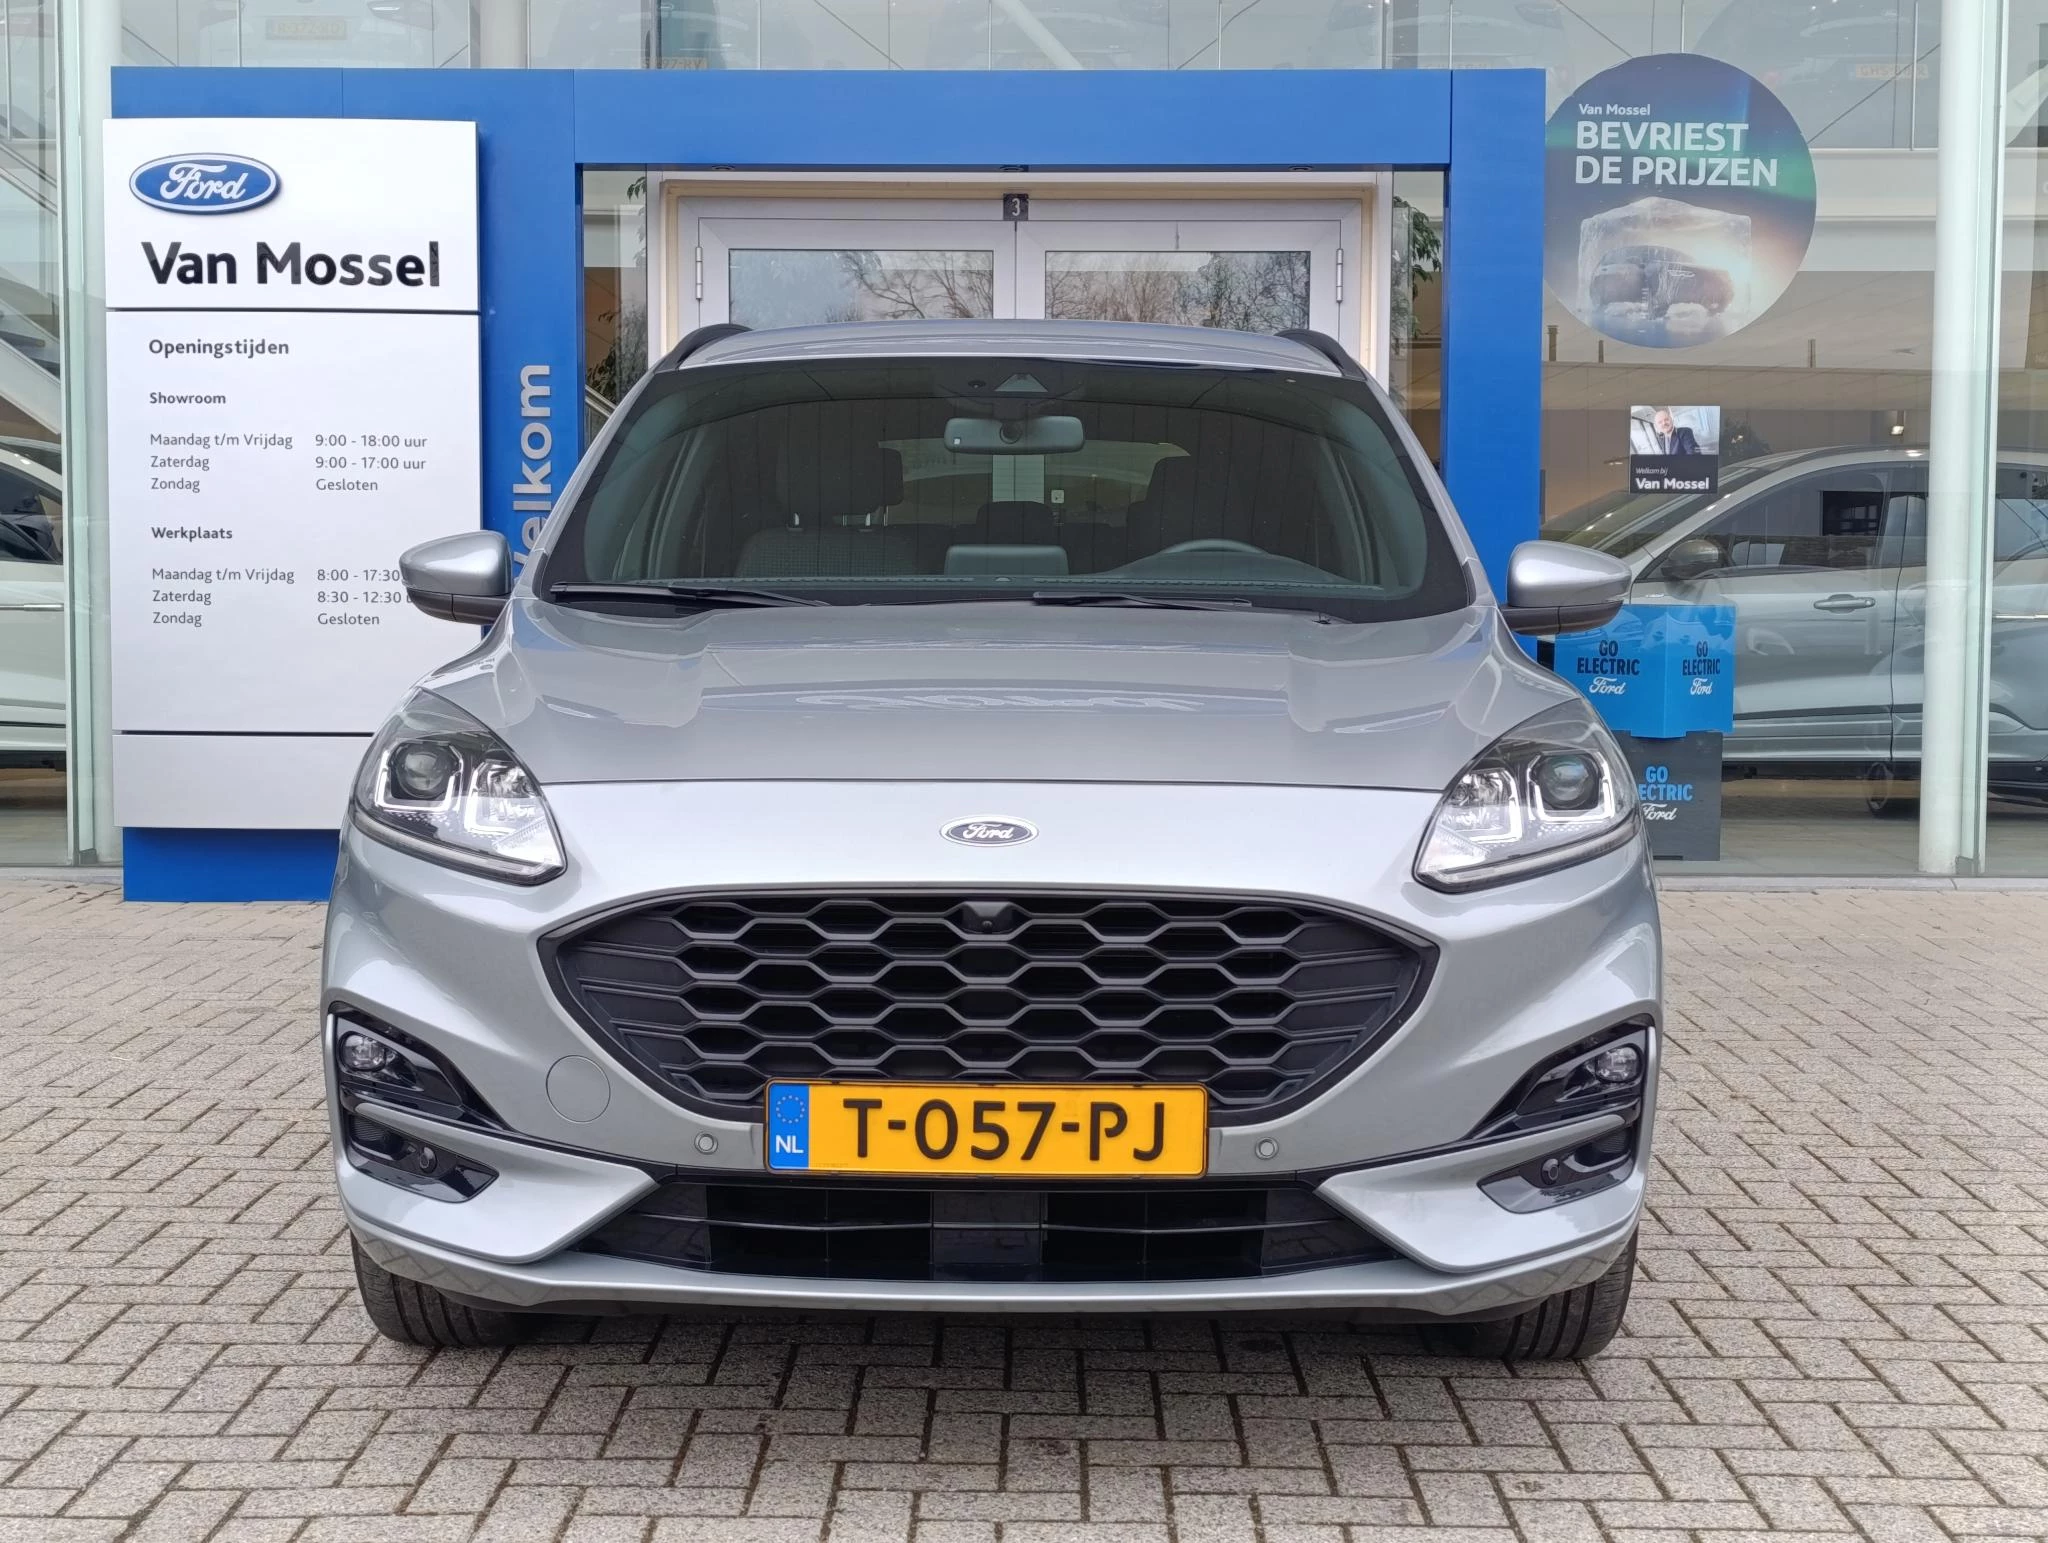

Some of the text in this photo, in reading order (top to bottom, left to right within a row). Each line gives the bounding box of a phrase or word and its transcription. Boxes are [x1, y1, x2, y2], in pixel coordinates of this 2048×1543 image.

[1578, 103, 1651, 116] Van Mossel
[1576, 120, 1749, 152] BEVRIEST
[1575, 155, 1778, 187] DE PRIJZEN
[159, 161, 249, 201] Ford
[1011, 197, 1020, 217] 3
[140, 240, 440, 287] Van Mossel
[148, 338, 290, 358] Openingstijden
[149, 391, 227, 405] Showroom
[150, 432, 294, 450] Maandag t/m Vrijdag
[315, 433, 347, 447] 9:00
[360, 434, 400, 448] 18:00
[404, 438, 428, 448] uur
[150, 455, 210, 472] Zaterdag
[315, 455, 347, 469] 9:00
[361, 456, 399, 470] 17:00
[403, 460, 427, 470] uur
[512, 364, 553, 570] elkom
[151, 477, 201, 494] Zondag
[315, 477, 379, 491] Gesloten
[1635, 477, 1710, 490] Van Mossel
[151, 524, 233, 543] Werkplaats
[152, 567, 295, 585] Maandag t/m Vrijdag
[317, 568, 349, 582] 8:00
[362, 569, 400, 582] 17:30
[152, 589, 212, 606] Zaterdag
[317, 590, 349, 604] 8:30
[362, 591, 402, 604] 12:30
[152, 611, 203, 628] Zondag
[317, 612, 380, 625] Gesloten
[1598, 640, 1619, 657] GO
[1696, 640, 1709, 658] GO
[1577, 657, 1640, 676] ELECTRIC
[1682, 658, 1721, 676] ELECTRIC
[1588, 676, 1627, 695] Ford
[1690, 677, 1713, 696] Ford
[1645, 766, 1669, 784] GO
[1637, 783, 1694, 801] ECTRIC
[961, 822, 1015, 840] Ford
[842, 1097, 1166, 1162] T-057-PJ
[774, 1134, 805, 1155] NL
